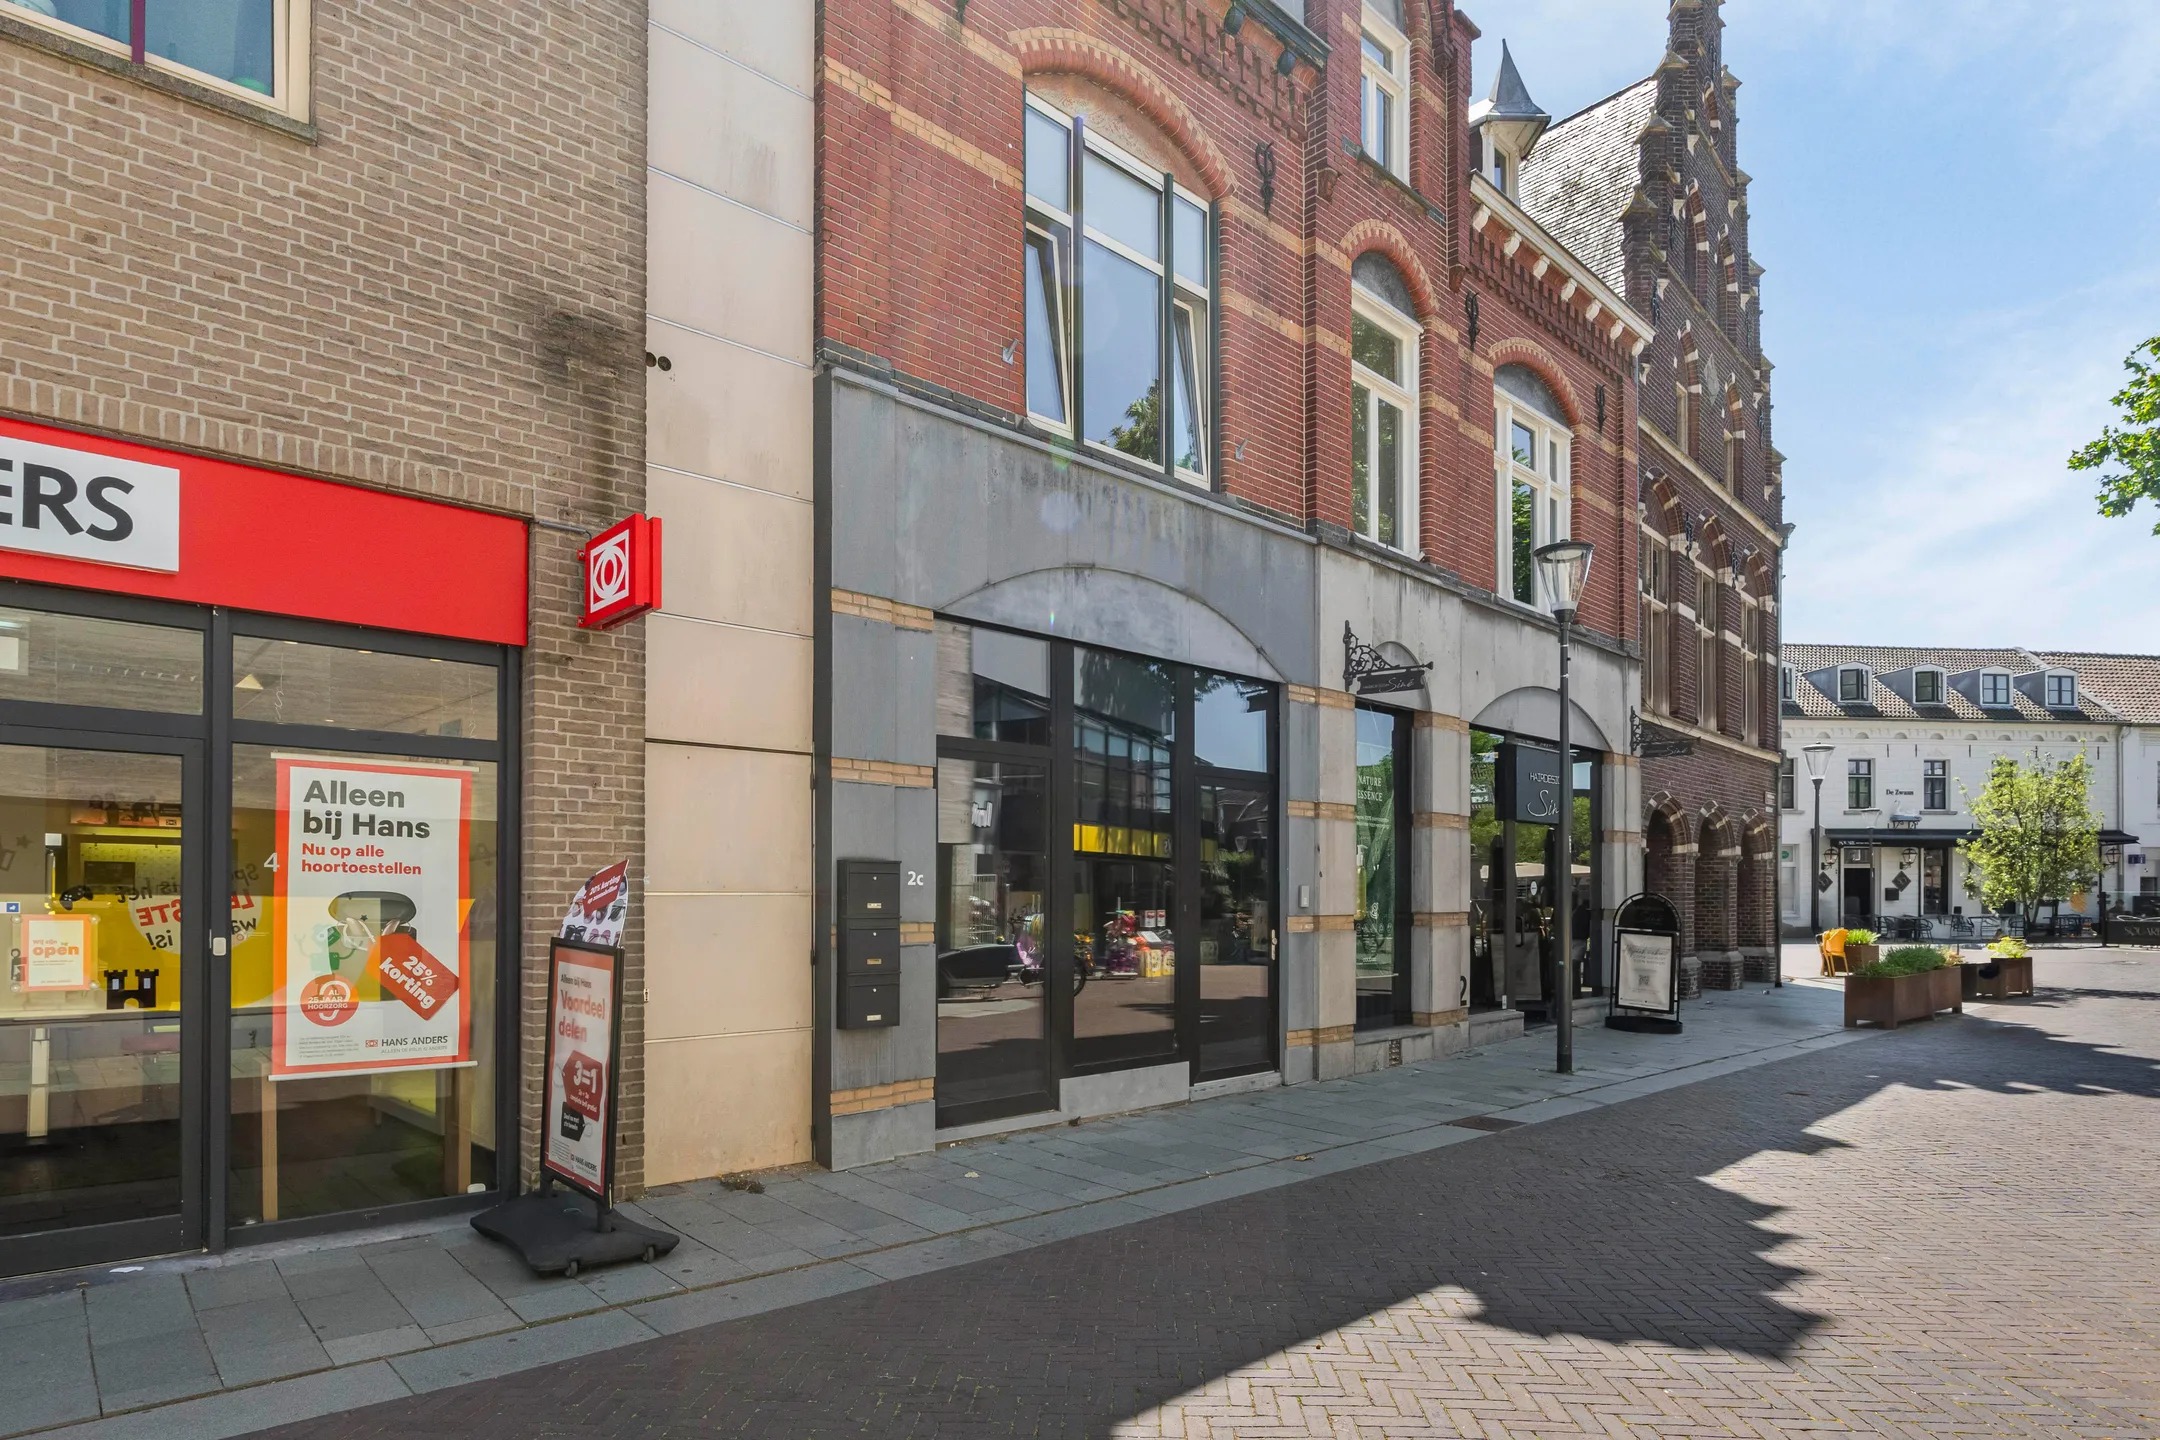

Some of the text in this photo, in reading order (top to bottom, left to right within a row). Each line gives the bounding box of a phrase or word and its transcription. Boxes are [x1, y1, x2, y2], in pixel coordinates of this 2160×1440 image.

[303, 780, 405, 808] Alleen
[1358, 775, 1382, 787] NATURE
[1357, 789, 1383, 801] ESSENCE
[1527, 789, 1560, 817] Sin
[303, 809, 430, 841] bij Hans
[263, 852, 280, 873] 4
[302, 843, 384, 859] Nu op alle
[302, 860, 421, 875] hoortoestellen
[907, 871, 924, 886] 2c
[32, 946, 80, 958] open
[379, 957, 436, 1009] korting
[402, 956, 437, 986] 25%
[560, 989, 606, 1019] Voordeel
[1460, 975, 1467, 1007] 2
[381, 1035, 448, 1047] HANS ANDERS
[559, 1016, 588, 1042] delen
[573, 1060, 597, 1094] 3=1
